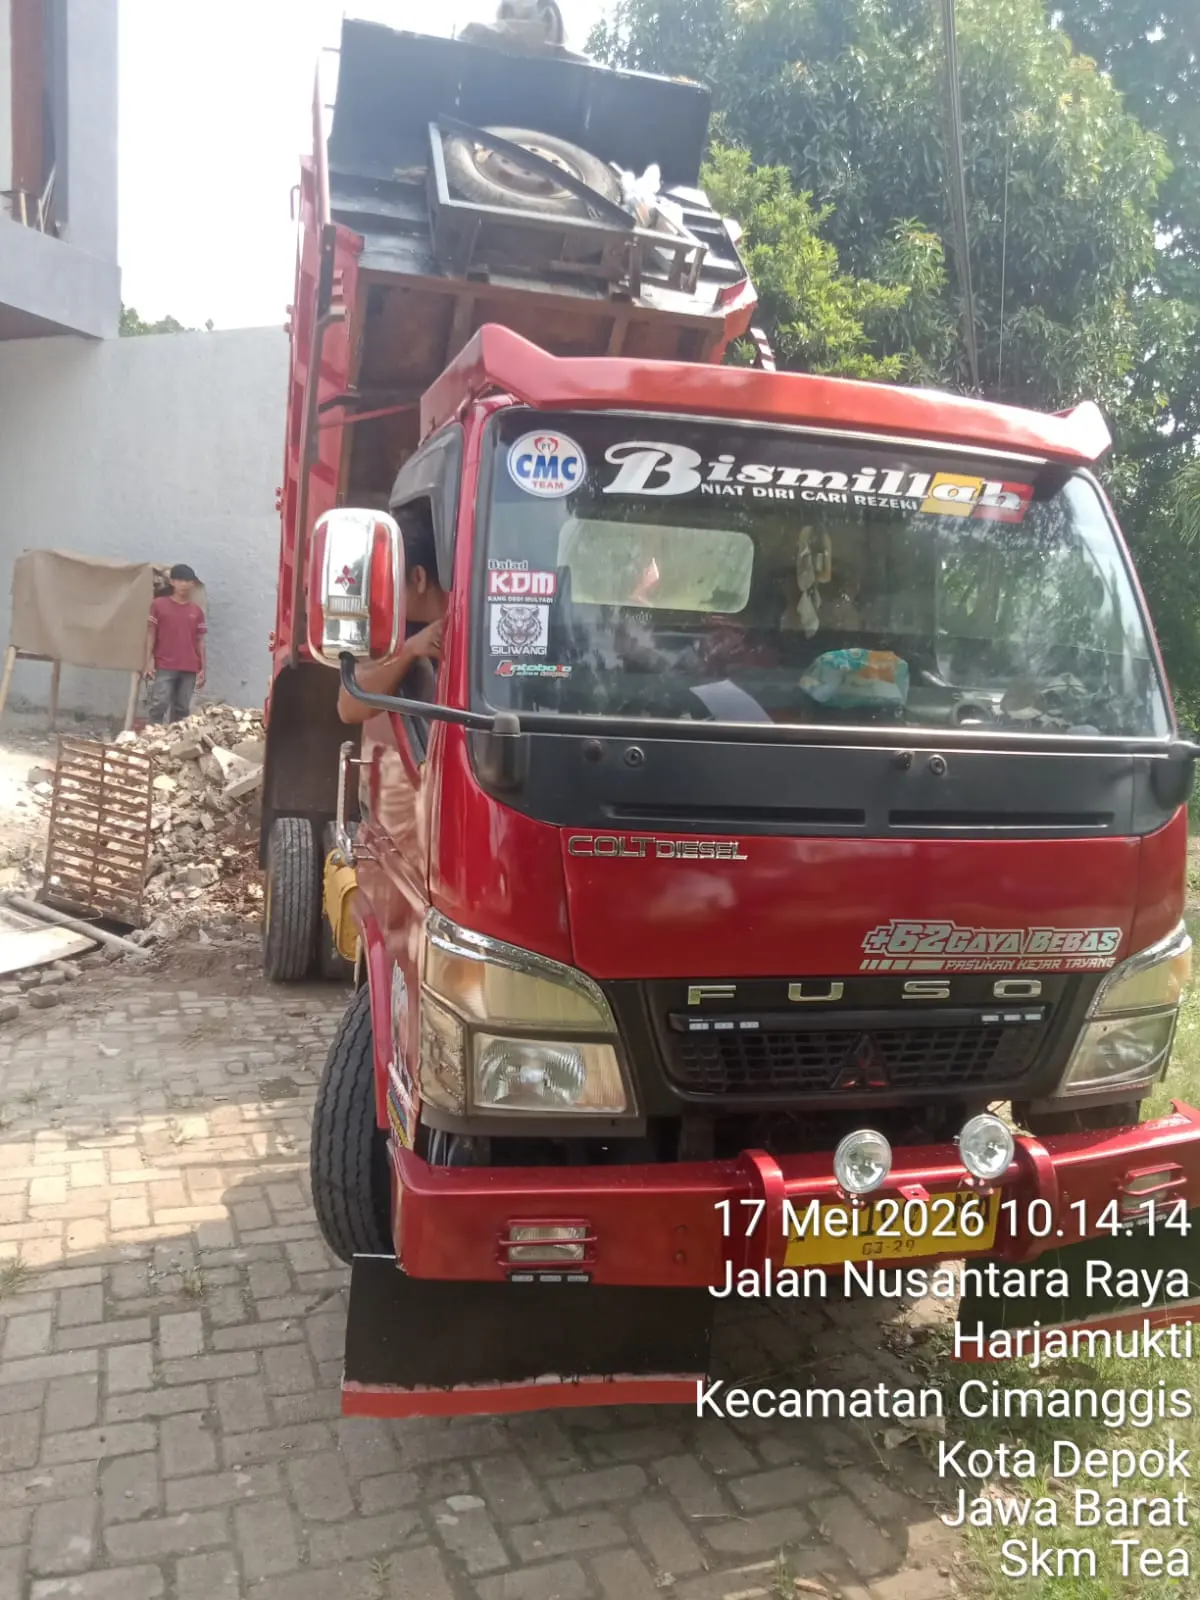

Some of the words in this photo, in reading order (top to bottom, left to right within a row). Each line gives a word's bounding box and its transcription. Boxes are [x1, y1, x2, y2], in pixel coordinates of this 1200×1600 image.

[516, 453, 578, 481] CMC
[602, 440, 1020, 510] Bismillah
[532, 480, 564, 489] TEAM
[701, 484, 745, 496] NIAT
[752, 486, 795, 500] DIRI
[801, 490, 848, 504] CARI
[854, 494, 918, 511] REZEKI
[490, 571, 556, 595] KDM
[491, 646, 547, 656] SILIWANGI
[568, 835, 656, 858] COLT
[655, 840, 748, 860] DIESEL
[864, 924, 952, 953] +62
[946, 932, 1022, 953] GAYA
[1028, 930, 1120, 953] BEBAS
[944, 959, 1013, 970] PASUKAN
[1016, 959, 1061, 971] KEJAR
[1064, 956, 1117, 969] TAYANG
[687, 979, 1043, 1005] FUSO
